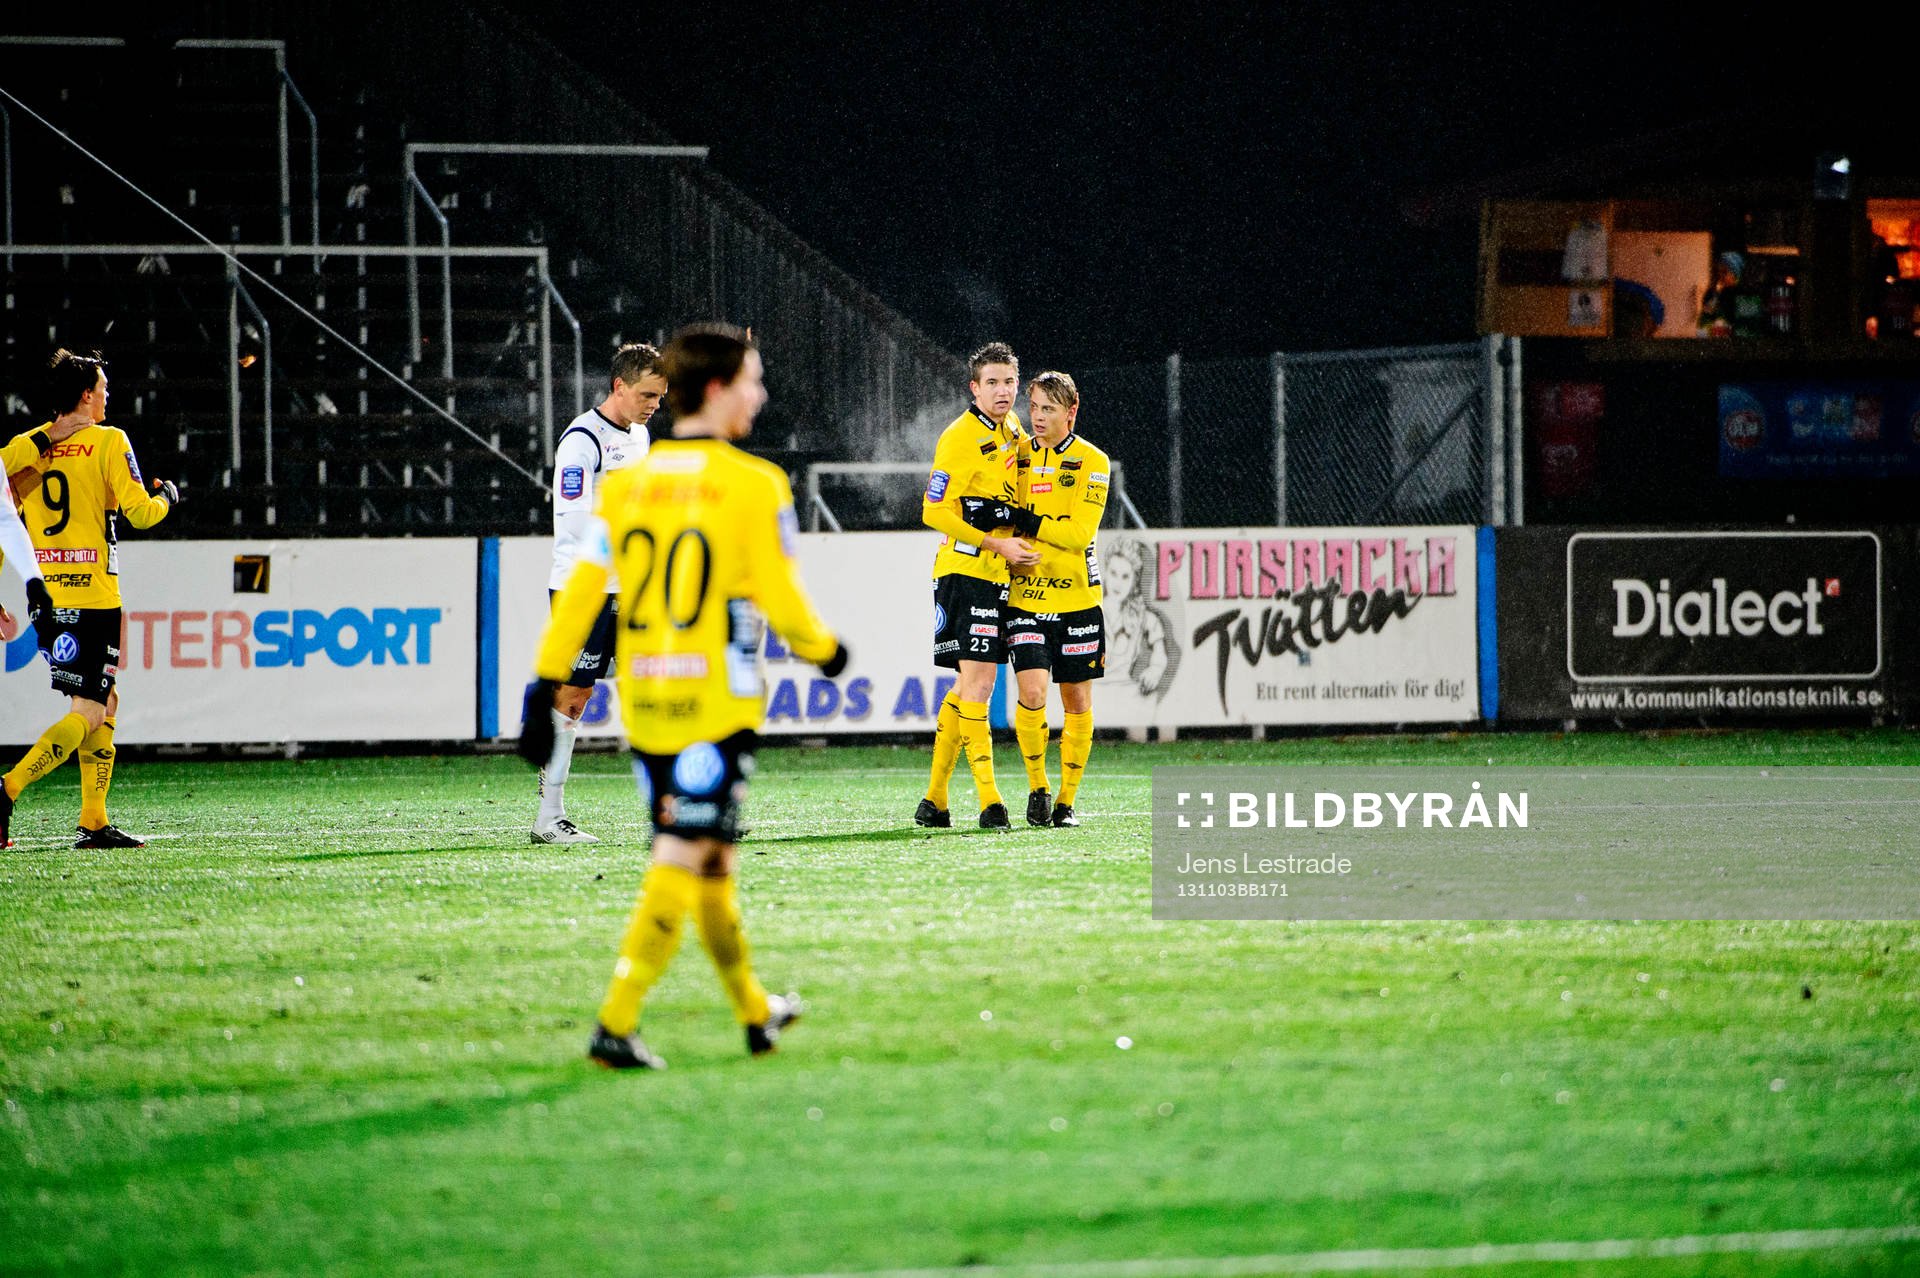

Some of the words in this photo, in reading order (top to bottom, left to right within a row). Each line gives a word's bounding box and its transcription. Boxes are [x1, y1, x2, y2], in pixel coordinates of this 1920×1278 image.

[50, 444, 94, 457] SEN
[42, 469, 70, 536] 9
[35, 551, 62, 562] TEAM
[64, 550, 97, 562] SPORTIA
[43, 574, 92, 582] OOPER
[623, 528, 711, 630] 20
[1022, 589, 1046, 600] BIL
[1612, 577, 1824, 637] Dialect
[121, 606, 441, 670] TERSPORT
[970, 638, 989, 652] 25
[1193, 578, 1422, 717] Tvätten
[1256, 682, 1278, 700] Ett
[1284, 683, 1317, 700] rent
[1321, 680, 1399, 700] alternativ
[1404, 678, 1429, 699] för
[1434, 678, 1465, 703] dig!
[1570, 687, 1880, 709] www.kommunikationsteknik.se
